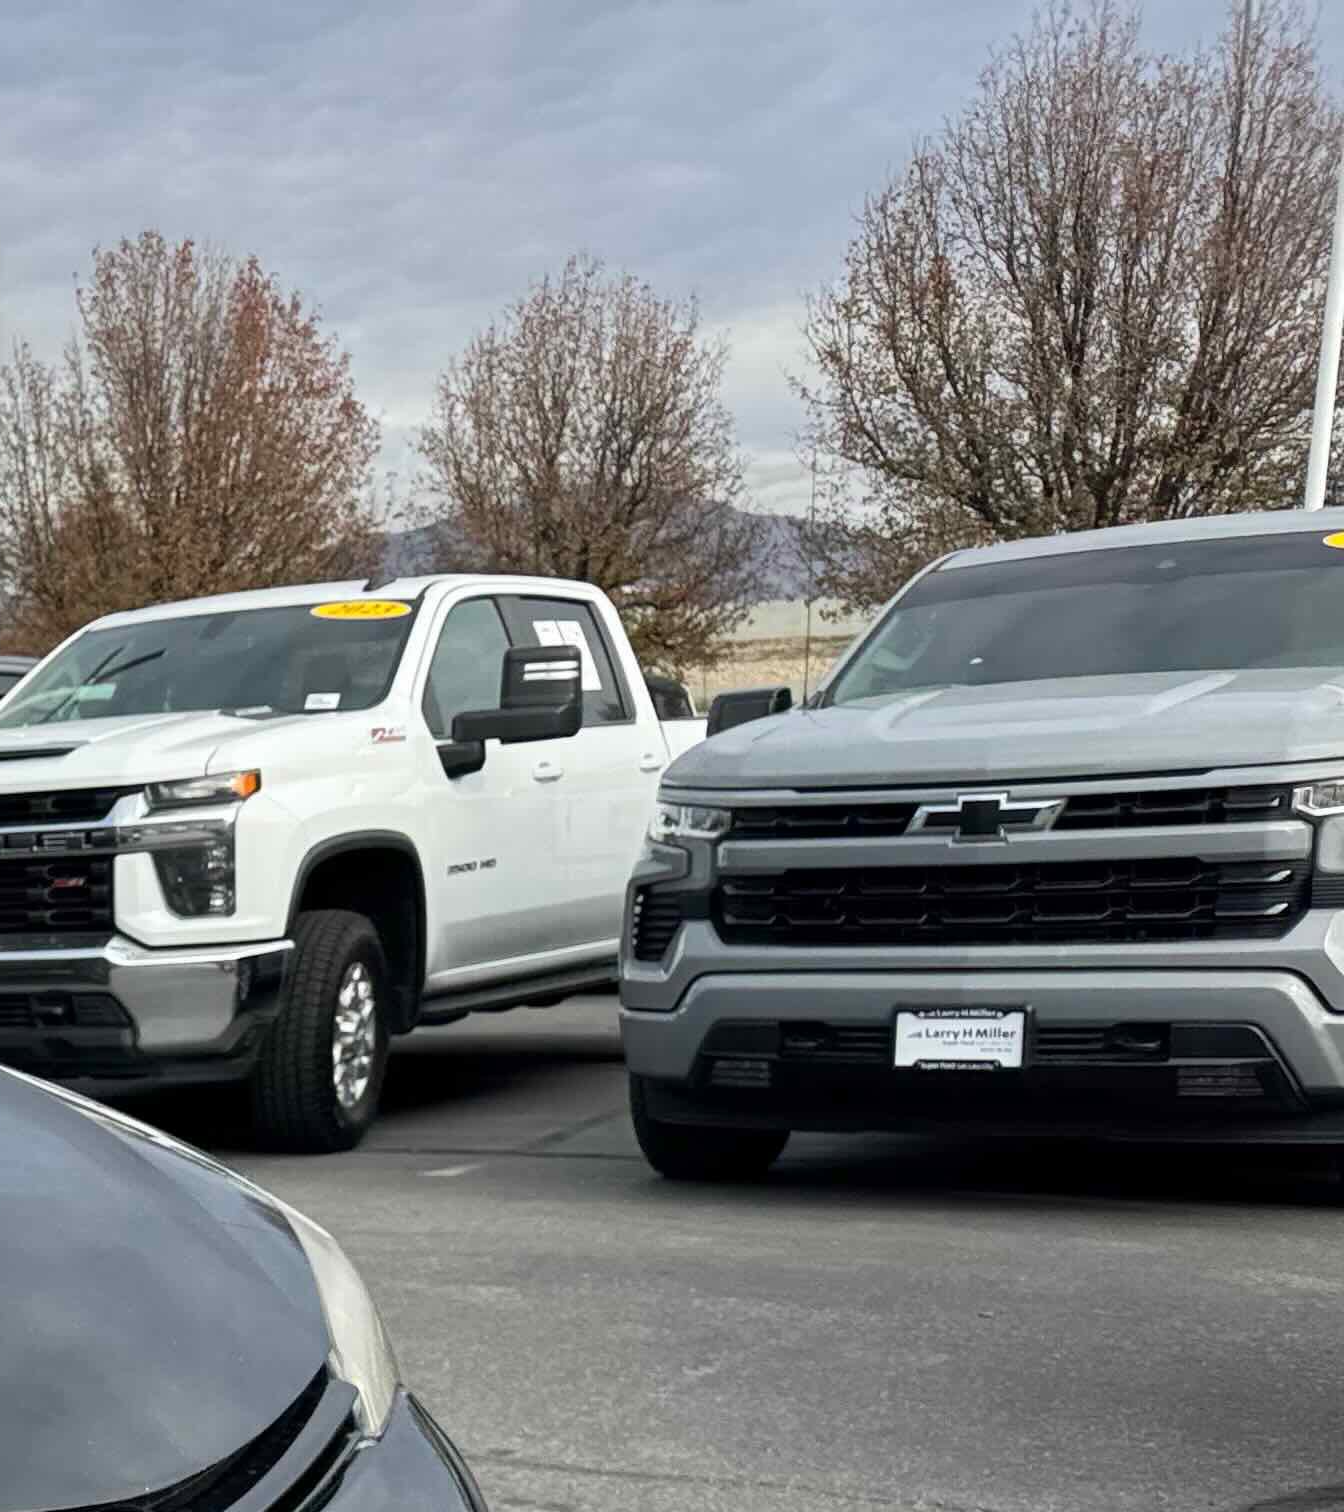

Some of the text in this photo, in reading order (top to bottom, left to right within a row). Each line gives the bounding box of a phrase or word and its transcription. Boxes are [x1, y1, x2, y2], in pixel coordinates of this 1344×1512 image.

[925, 1027, 1016, 1040] Larry H Miller
